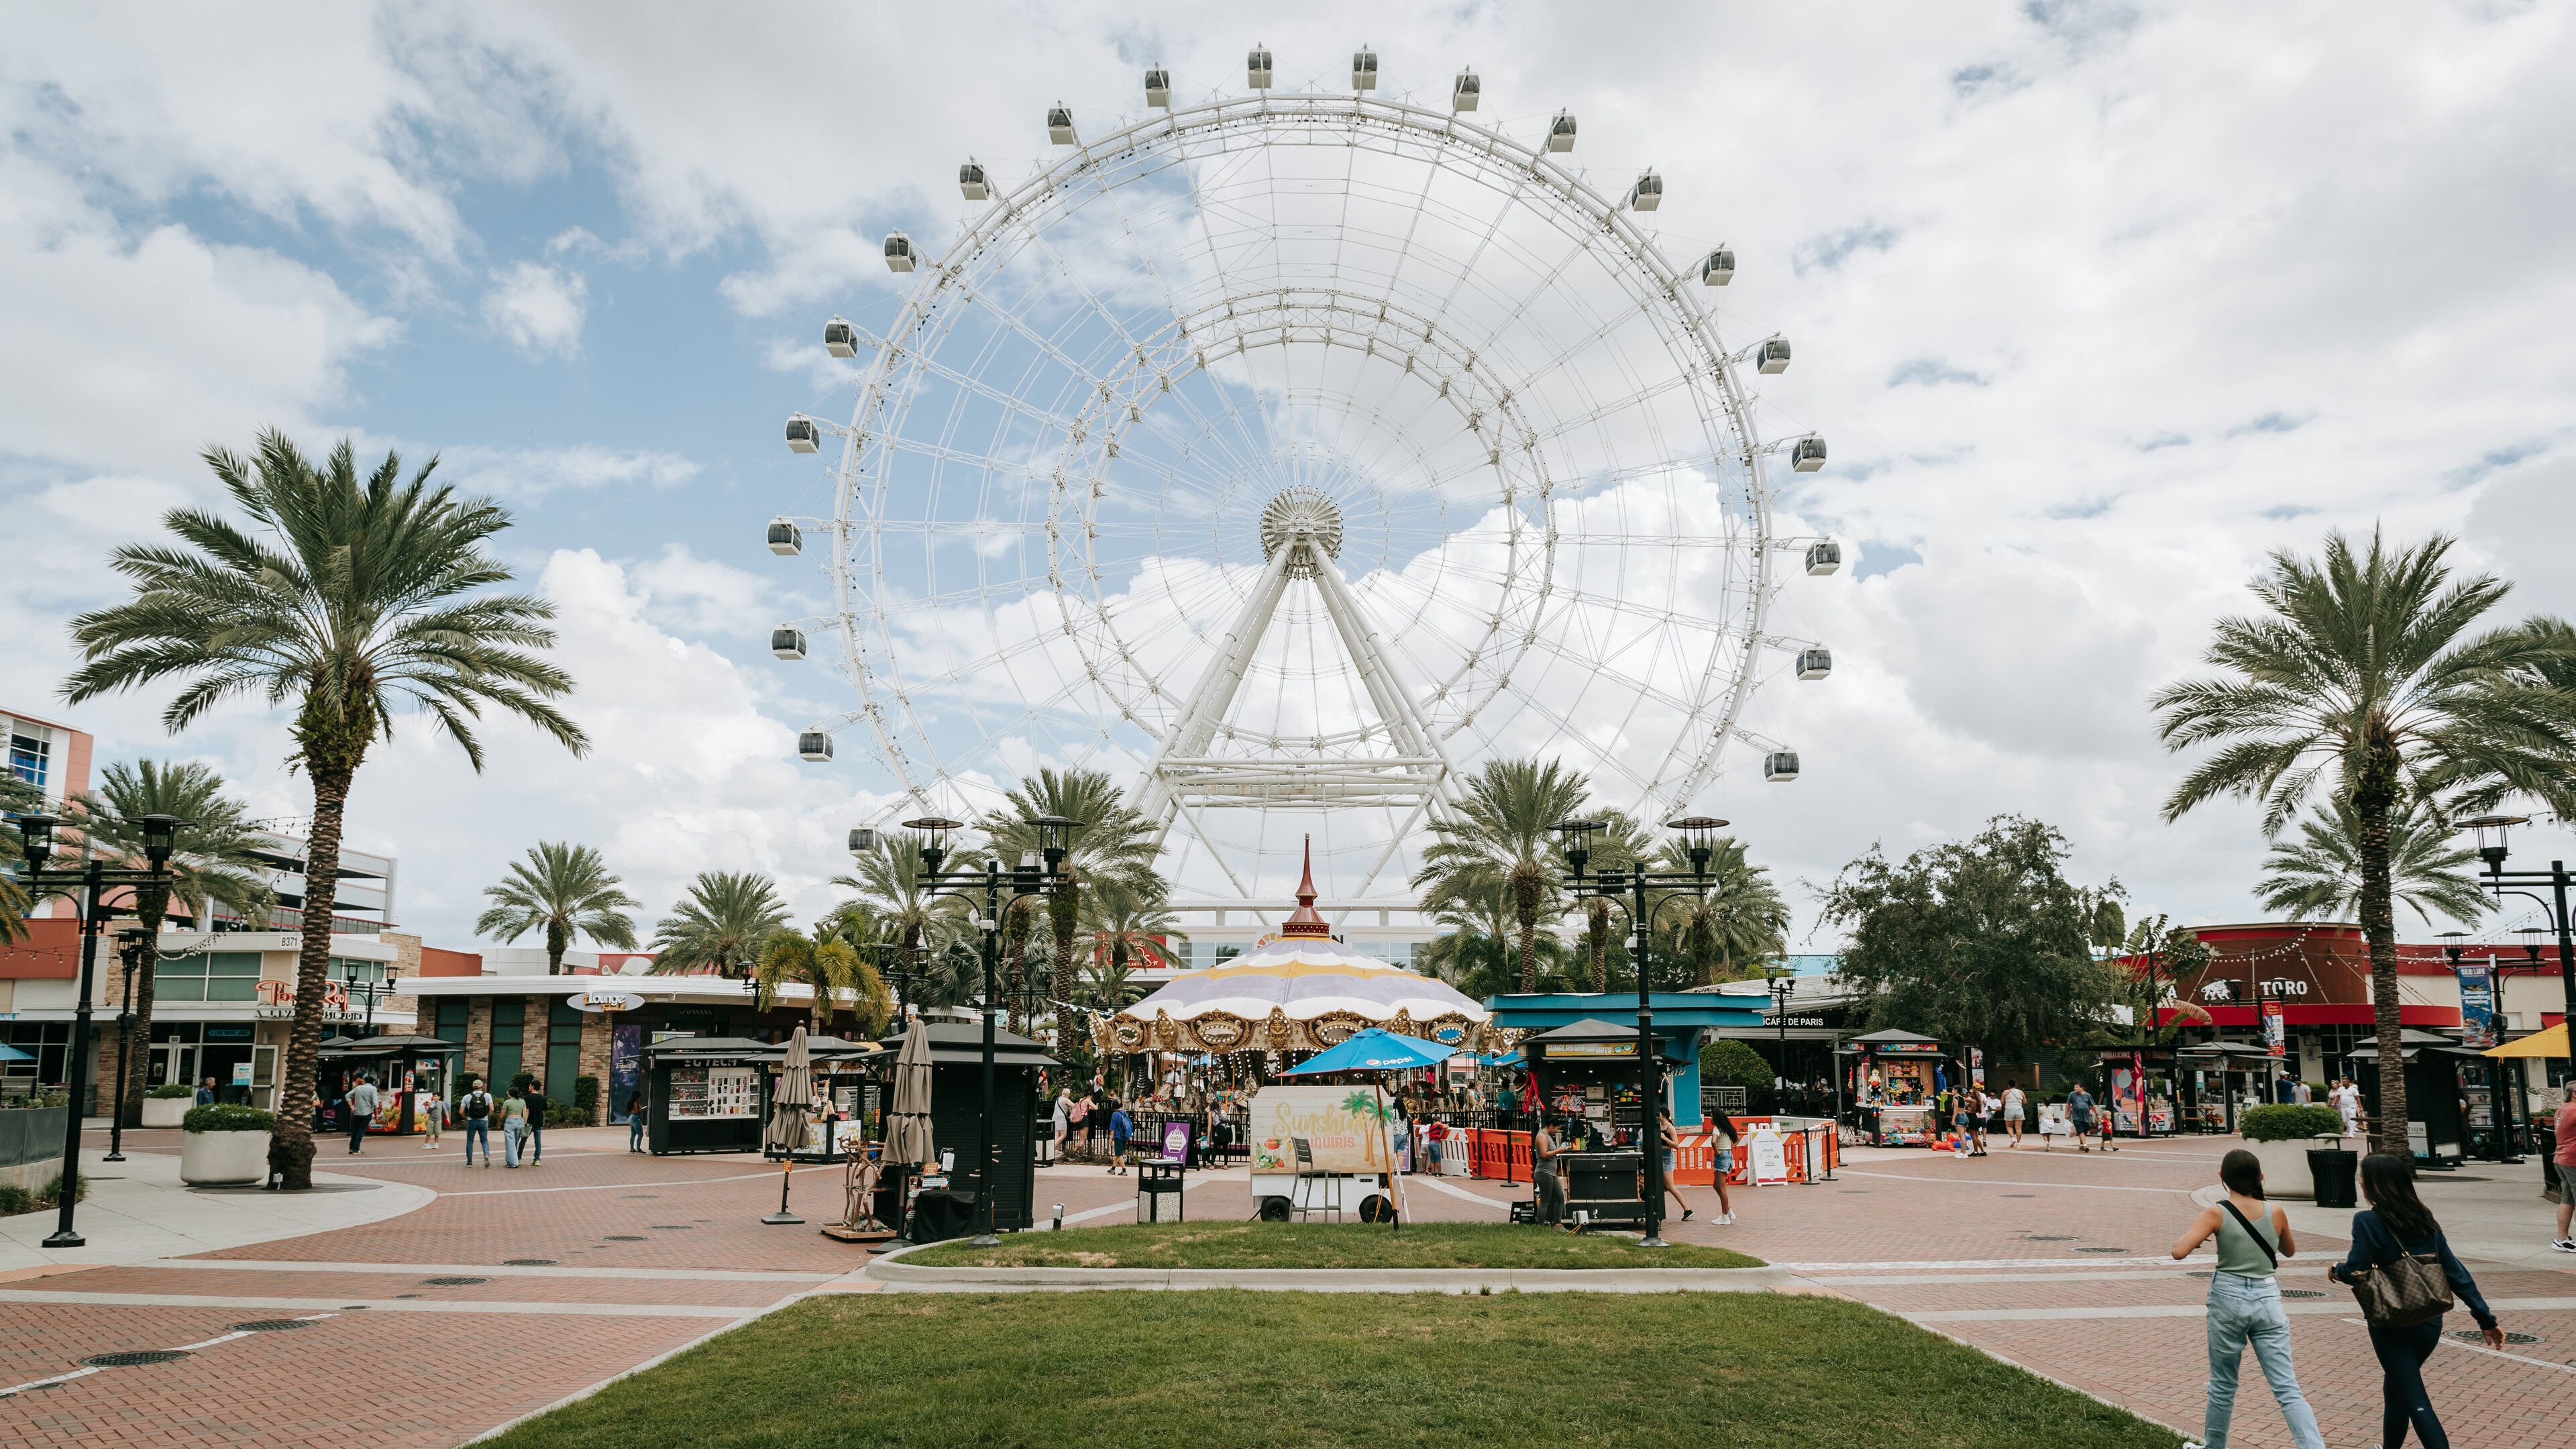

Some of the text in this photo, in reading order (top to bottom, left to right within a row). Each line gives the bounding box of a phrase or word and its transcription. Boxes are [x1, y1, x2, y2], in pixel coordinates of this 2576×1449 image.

[282, 937, 297, 947] 8371
[254, 979, 296, 1006] Tin
[2259, 980, 2308, 996] TORO
[1788, 1018, 1799, 1026] DE
[1801, 1018, 1823, 1026] PARIS
[705, 1059, 737, 1067] TECH
[1383, 1056, 1414, 1066] pepsi
[1309, 1136, 1356, 1149] IQUIRIS
